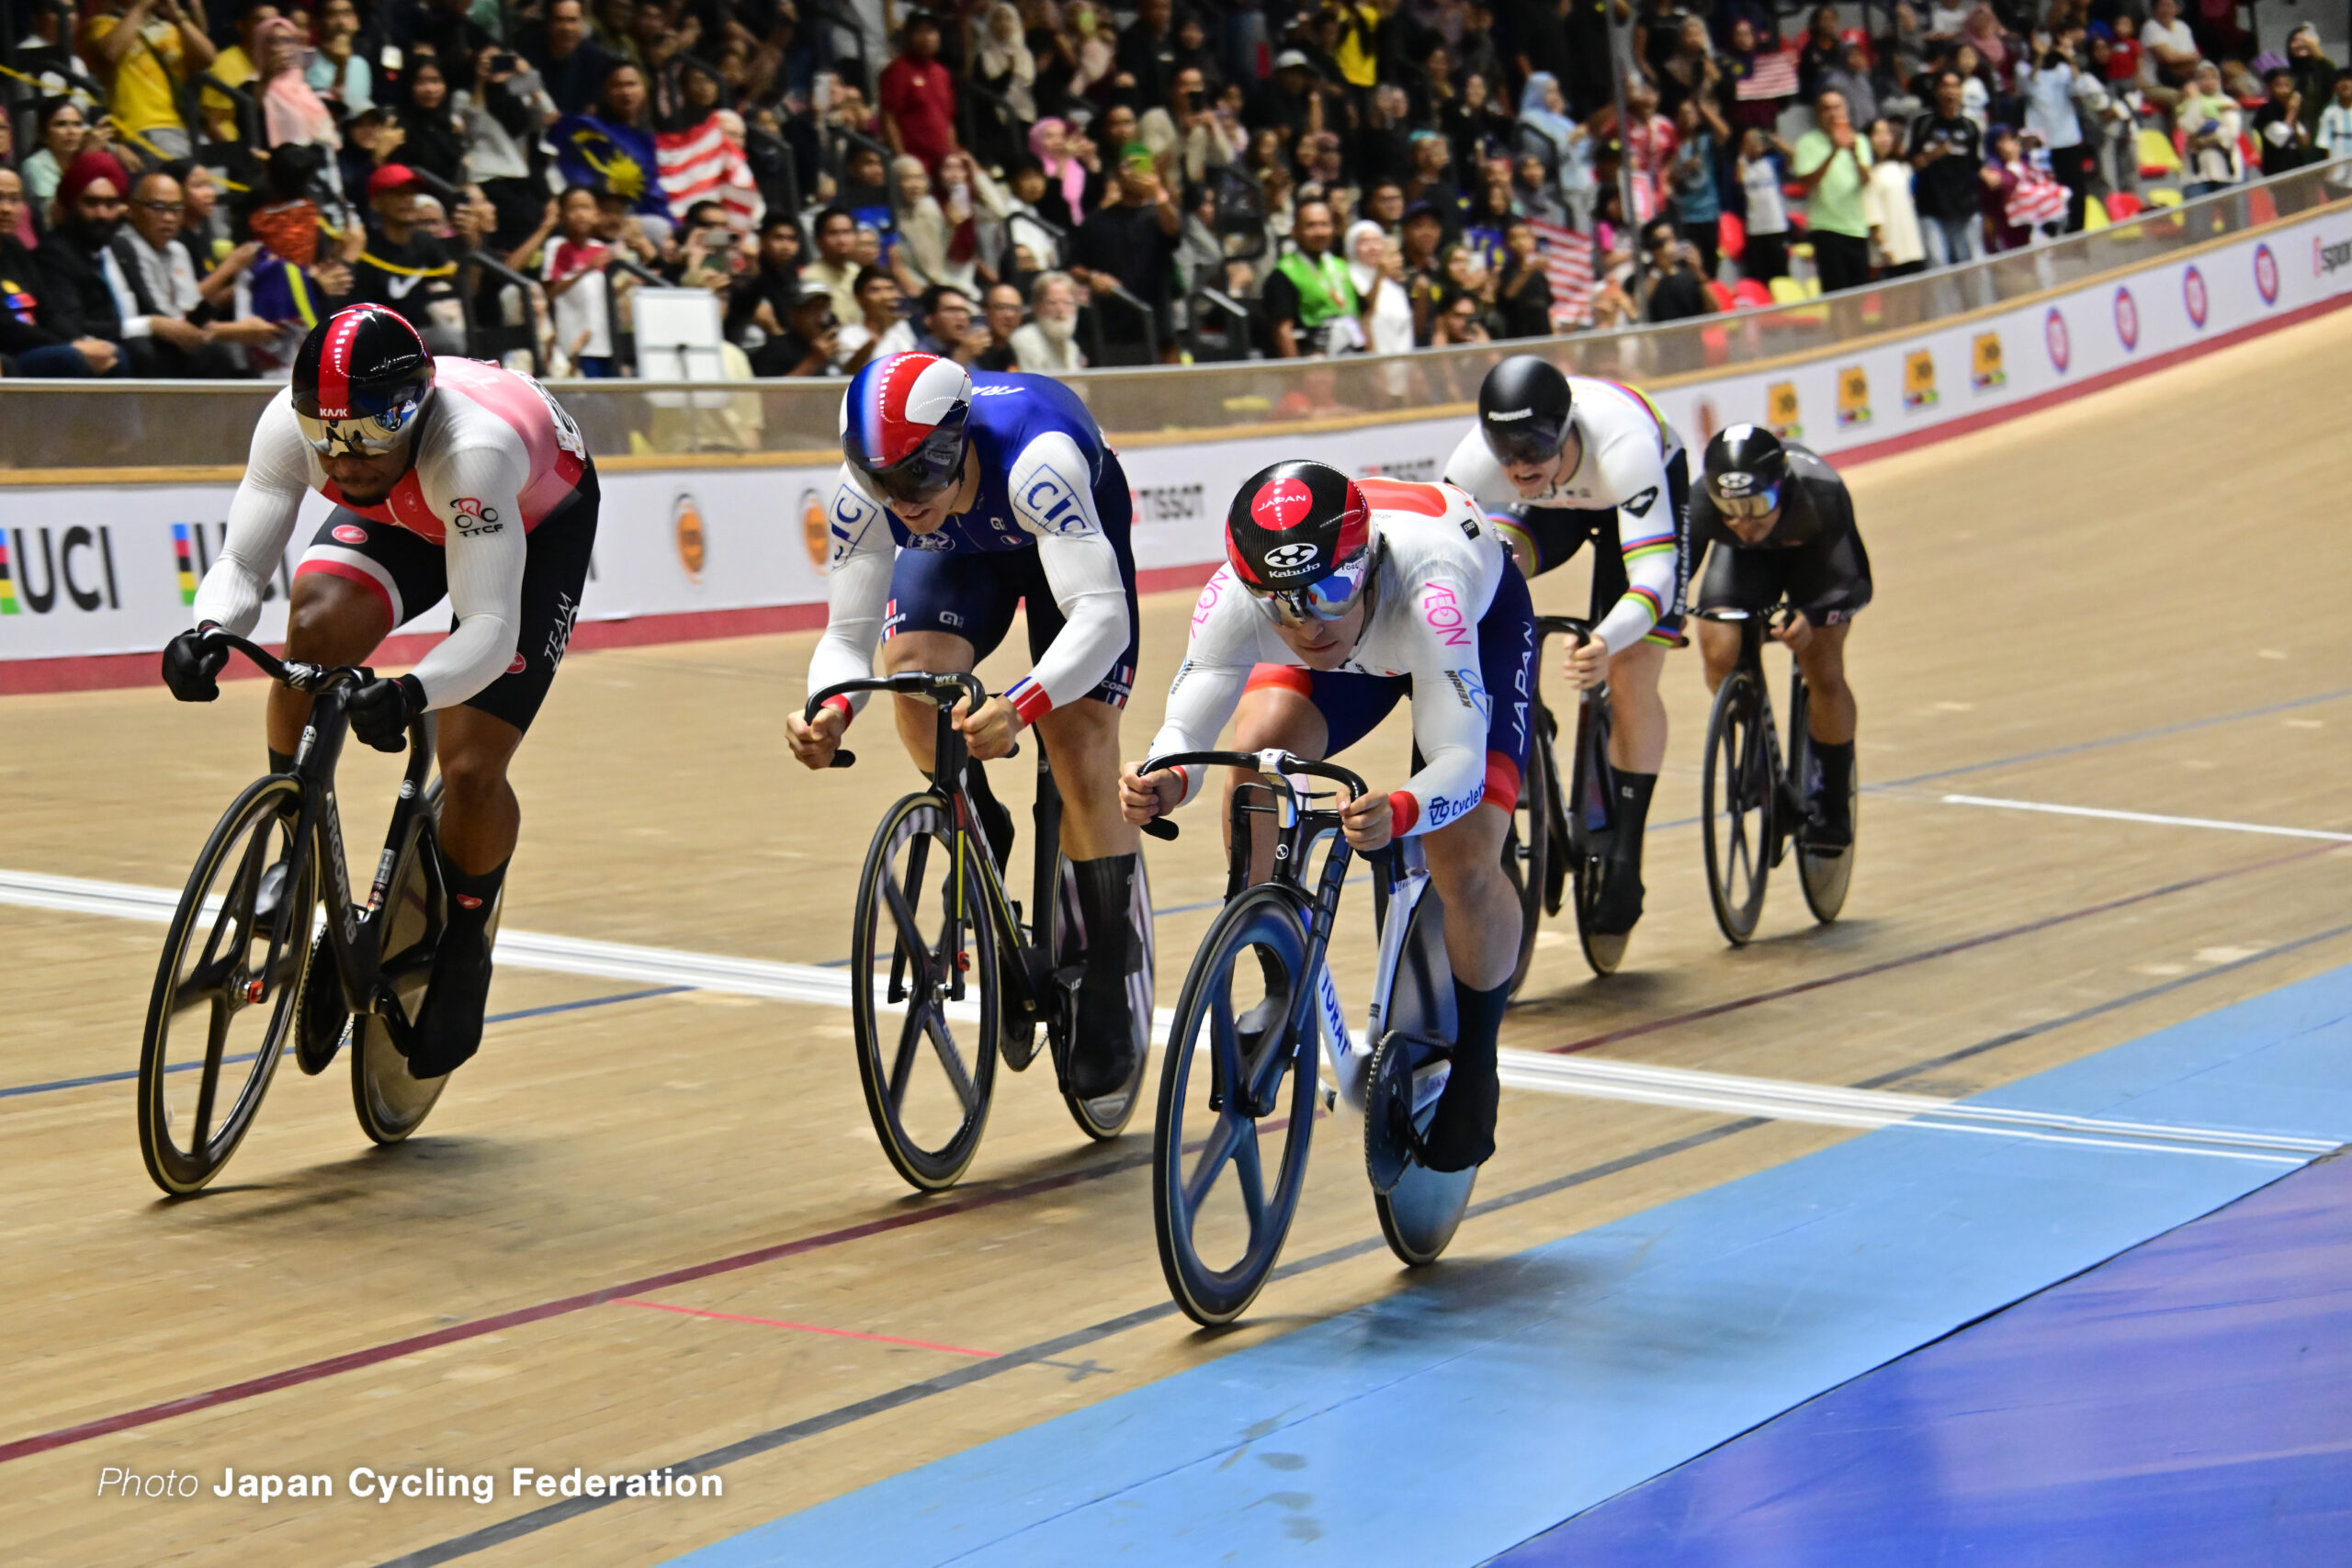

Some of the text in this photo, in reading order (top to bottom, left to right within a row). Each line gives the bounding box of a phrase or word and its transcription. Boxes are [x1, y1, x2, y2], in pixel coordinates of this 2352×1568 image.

[319, 408, 348, 417] KASK
[1257, 495, 1306, 512] JAPAN
[459, 524, 503, 537] TTCF
[11, 525, 120, 614] UCI
[1268, 562, 1321, 579] Kabuto
[544, 591, 571, 662] TEAM
[1444, 670, 1473, 709] KEIRIN
[1511, 621, 1533, 756] JAPAN
[326, 791, 352, 911] ARGON
